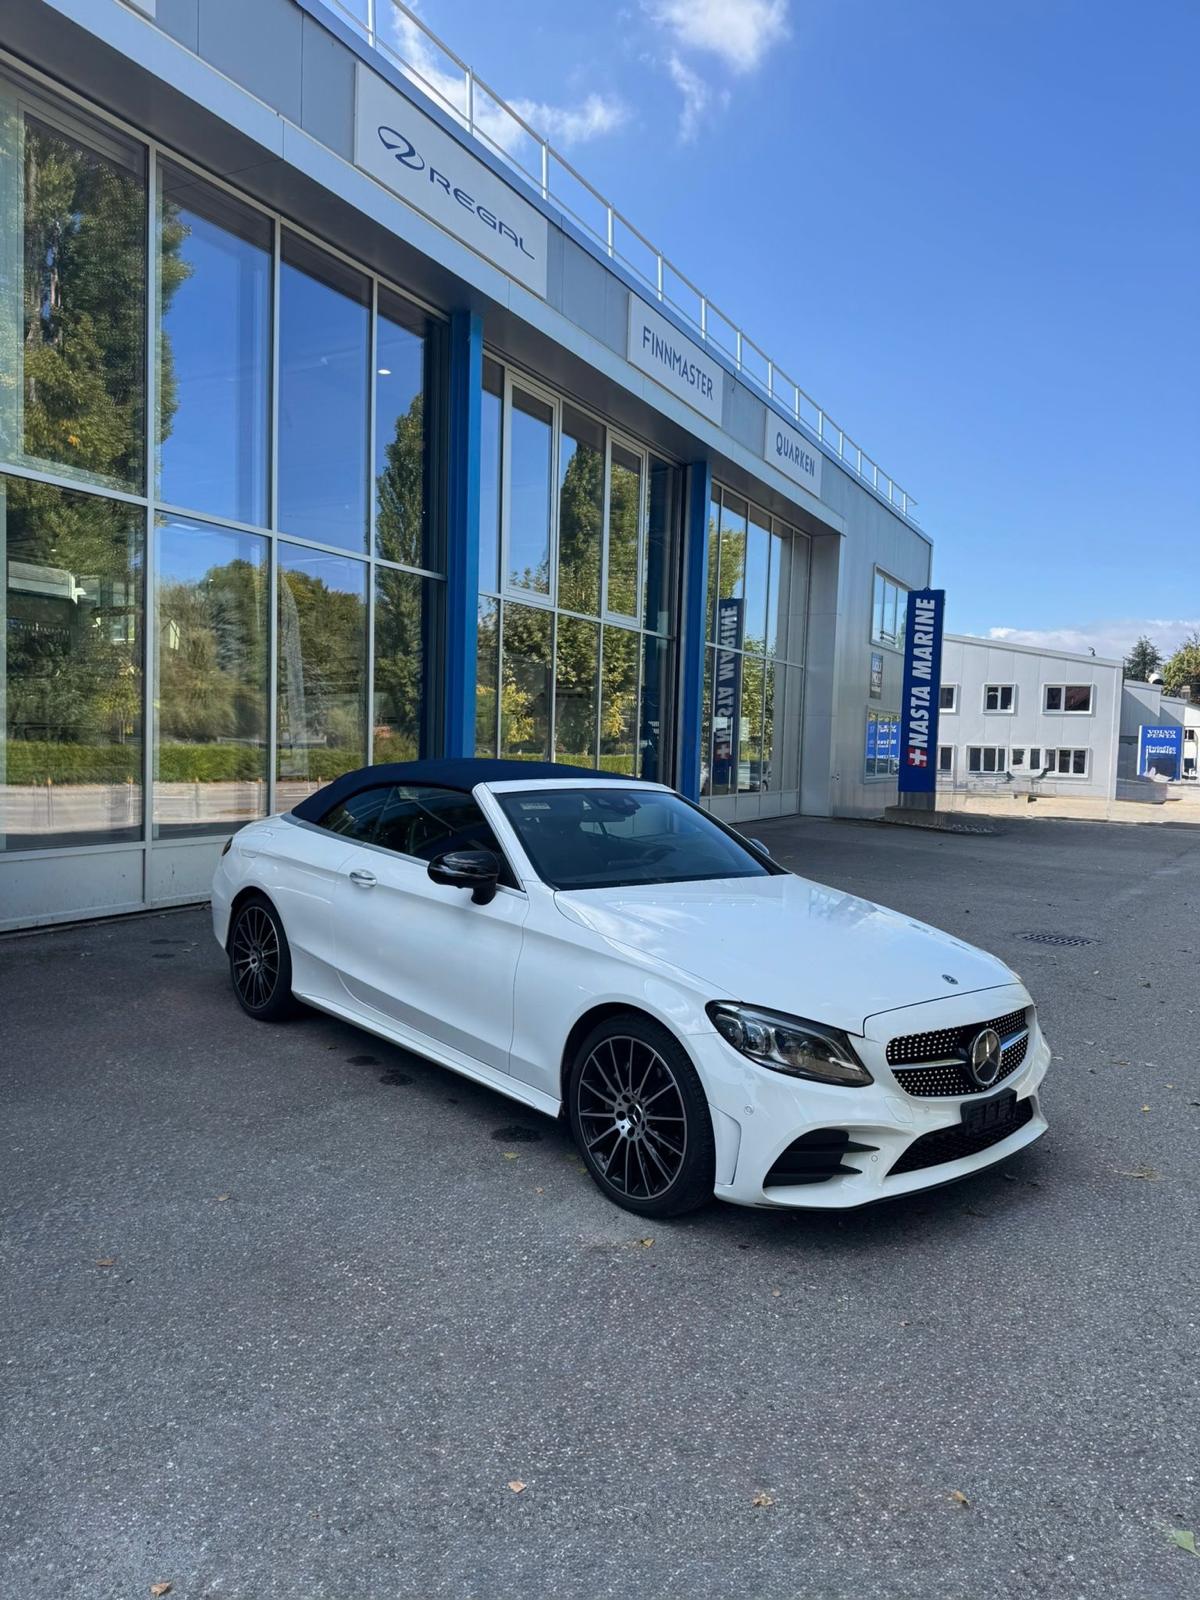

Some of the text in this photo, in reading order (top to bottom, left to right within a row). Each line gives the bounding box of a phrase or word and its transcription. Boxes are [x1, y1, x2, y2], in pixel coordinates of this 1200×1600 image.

[430, 167, 536, 261] REGAL
[643, 326, 713, 401] FINNMASTER
[776, 431, 815, 477] QUARKEN
[909, 598, 935, 748] NASTA MARINE
